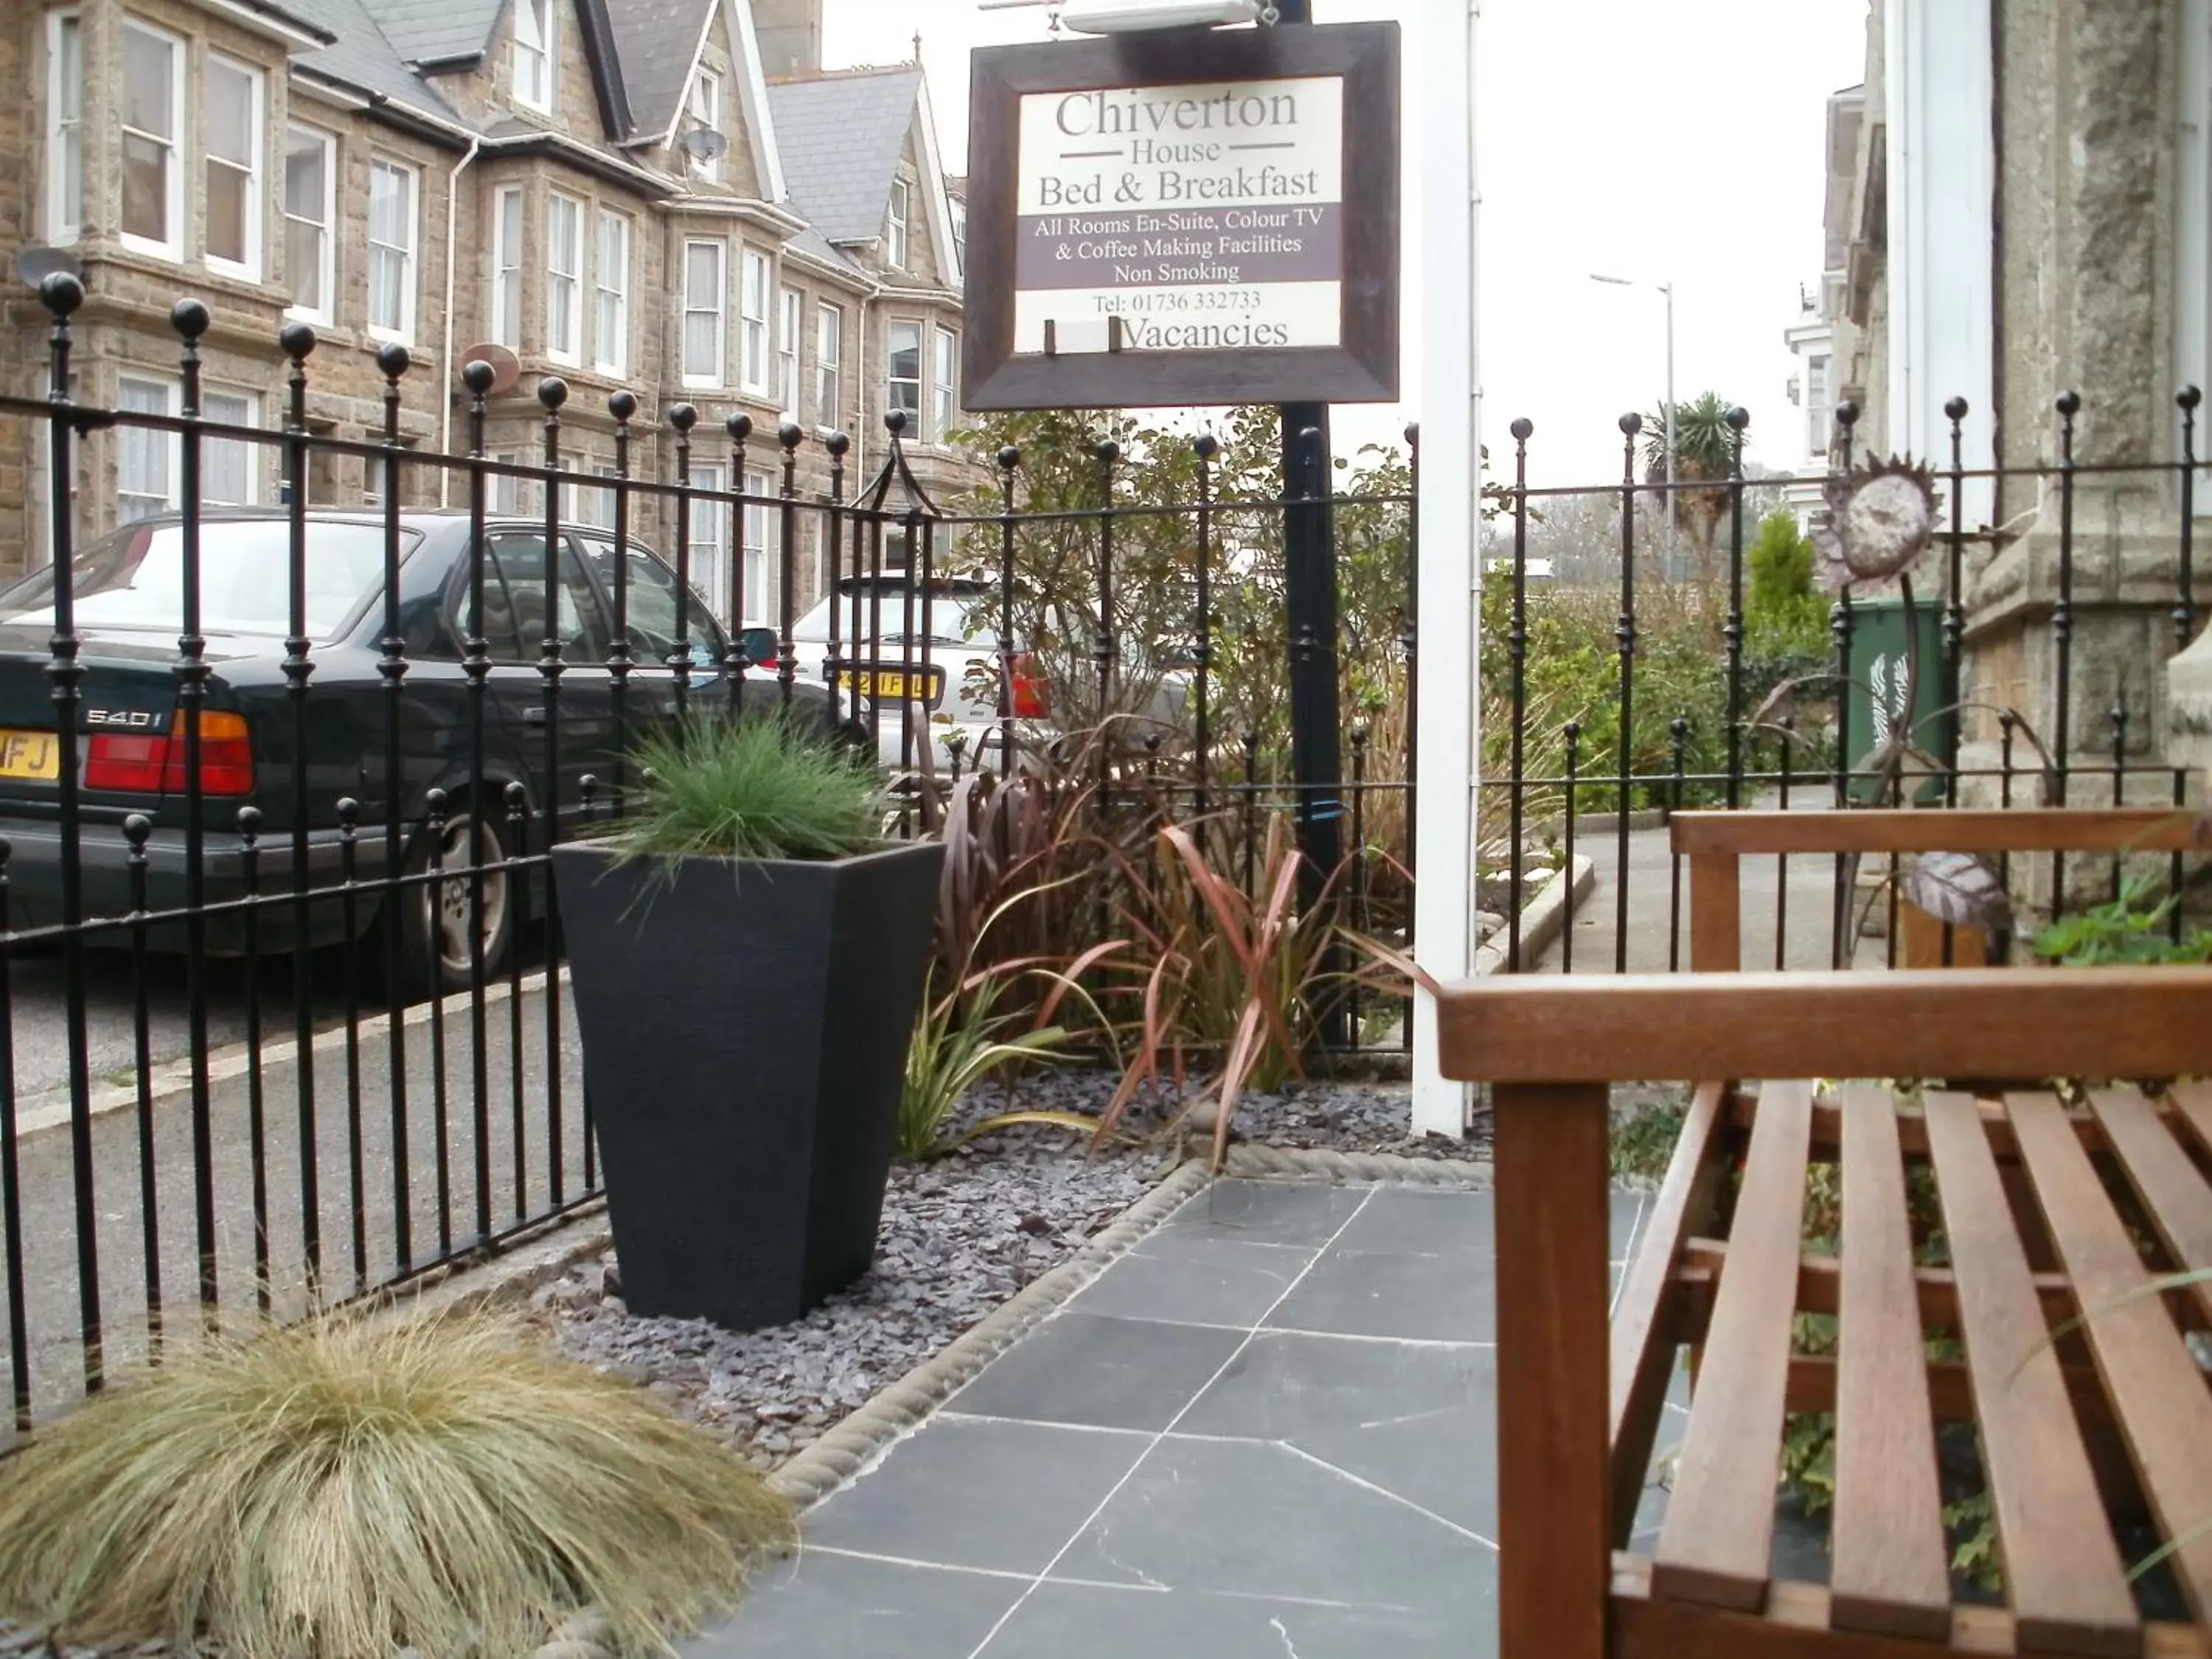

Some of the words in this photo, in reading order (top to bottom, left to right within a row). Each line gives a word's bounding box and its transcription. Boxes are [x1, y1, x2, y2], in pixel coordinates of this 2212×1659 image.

[1057, 89, 1297, 136] Chiverton
[1131, 139, 1220, 164] House
[1039, 174, 1102, 206] Bed
[1114, 172, 1144, 202] &
[1158, 166, 1318, 201] Breakfast
[1035, 218, 1062, 237] All
[1069, 218, 1130, 234] Rooms
[1137, 212, 1219, 232] En-Suite,
[1225, 210, 1288, 229] Colour
[1293, 207, 1324, 226] TV
[1056, 243, 1071, 260] &
[1079, 241, 1137, 259] Coffee
[1144, 237, 1213, 259] Making
[1219, 234, 1302, 254] Facilities
[1115, 265, 1152, 283] Non
[1158, 262, 1239, 284] Smoking
[1094, 294, 1127, 313] Tel:
[1133, 293, 1188, 311] 01736
[1194, 291, 1261, 310] 332733
[1120, 315, 1289, 348] Vacancies
